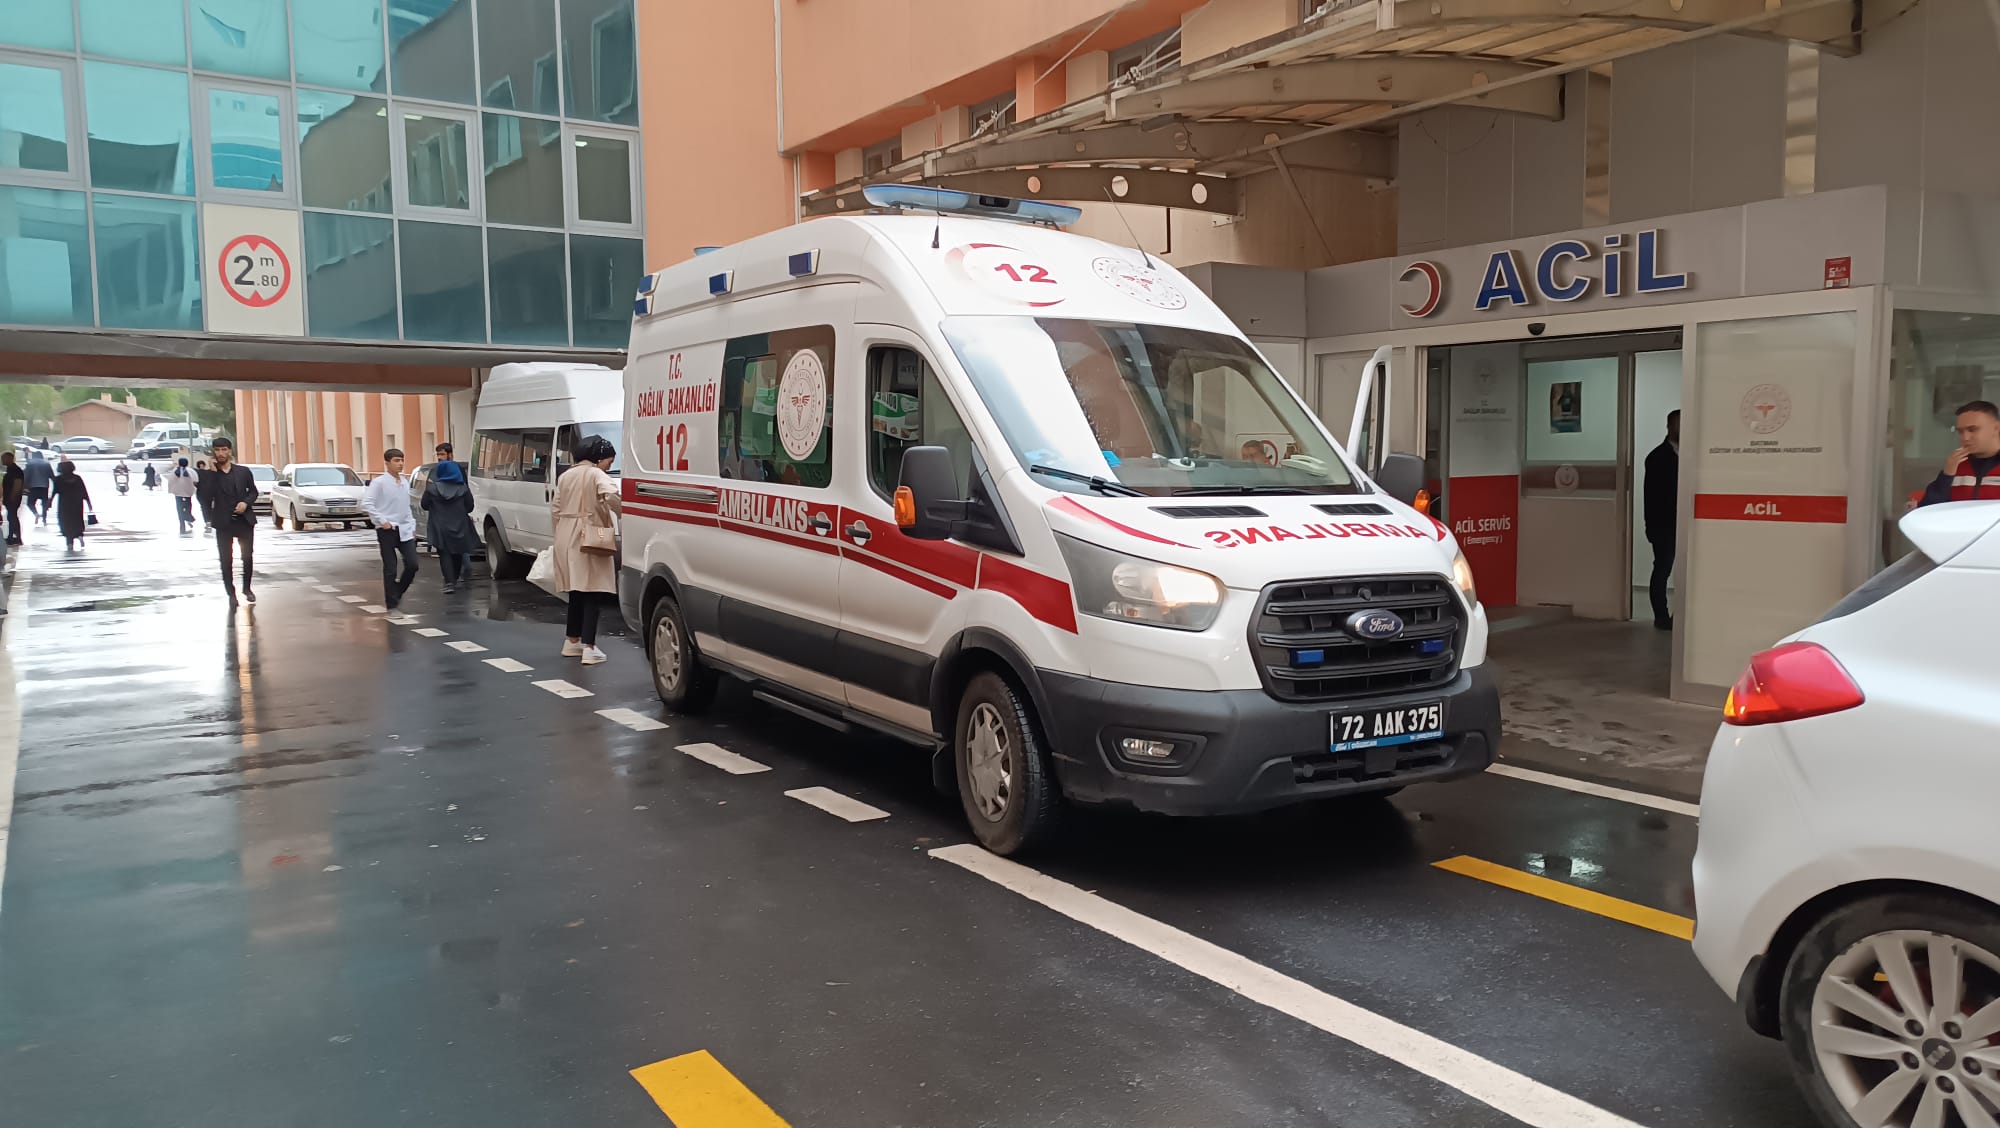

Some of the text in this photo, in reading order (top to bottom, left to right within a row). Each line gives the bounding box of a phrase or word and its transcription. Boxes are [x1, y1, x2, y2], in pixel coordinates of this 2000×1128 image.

[668, 352, 683, 381] T.C.
[637, 378, 717, 418] SAĞLIK BAKANLIĞI
[656, 423, 689, 471] 112
[718, 489, 809, 533] AMBULANS
[1455, 514, 1511, 534] ACİL SERVİS
[1743, 501, 1782, 516] ACİL
[1369, 617, 1395, 633] Ford
[1341, 706, 1439, 741] 72 AAK 375
